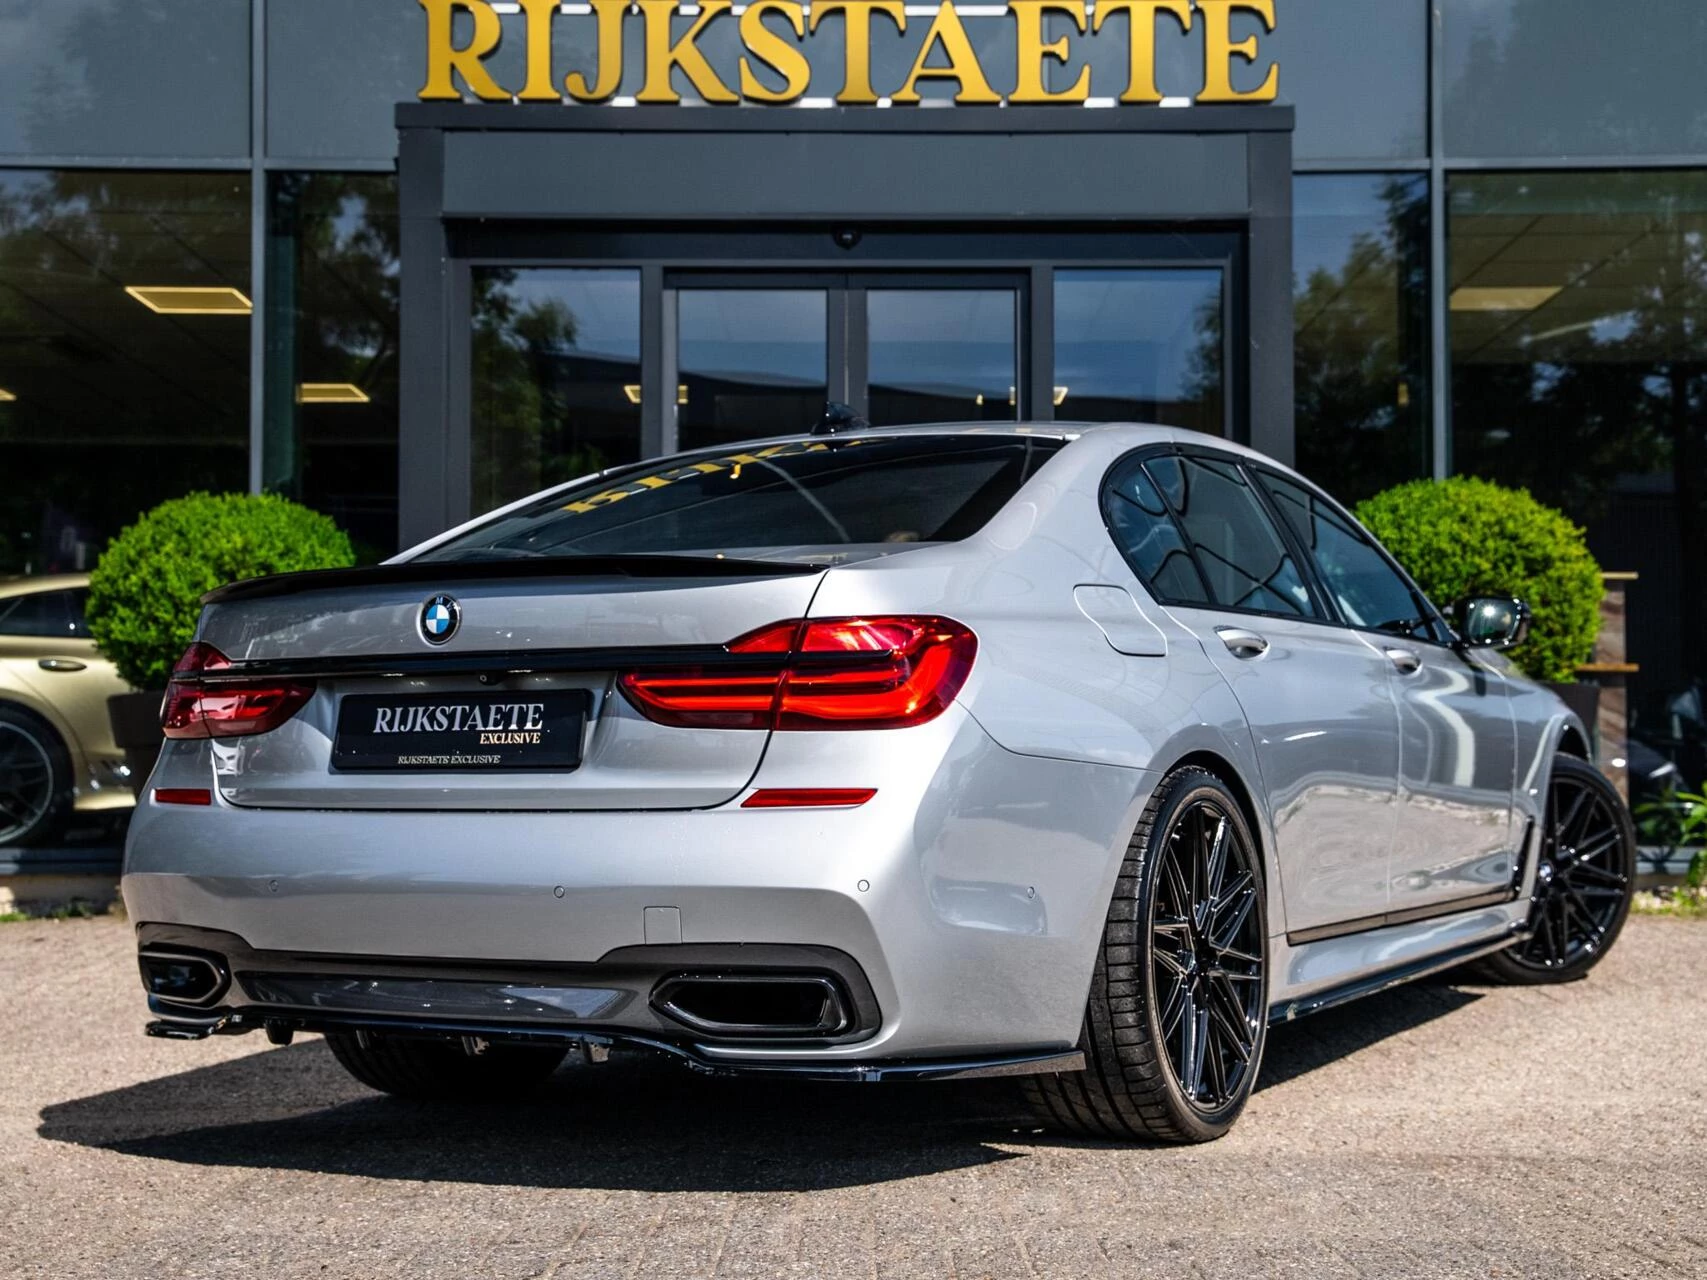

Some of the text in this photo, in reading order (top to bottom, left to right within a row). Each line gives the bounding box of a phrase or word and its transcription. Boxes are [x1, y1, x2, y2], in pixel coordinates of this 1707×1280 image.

[417, 0, 1279, 103] RIJKSTAETE
[373, 703, 544, 733] RIJKSTAETE
[479, 732, 541, 745] EXCLUSIVE
[450, 754, 502, 764] EXCLUSIVE
